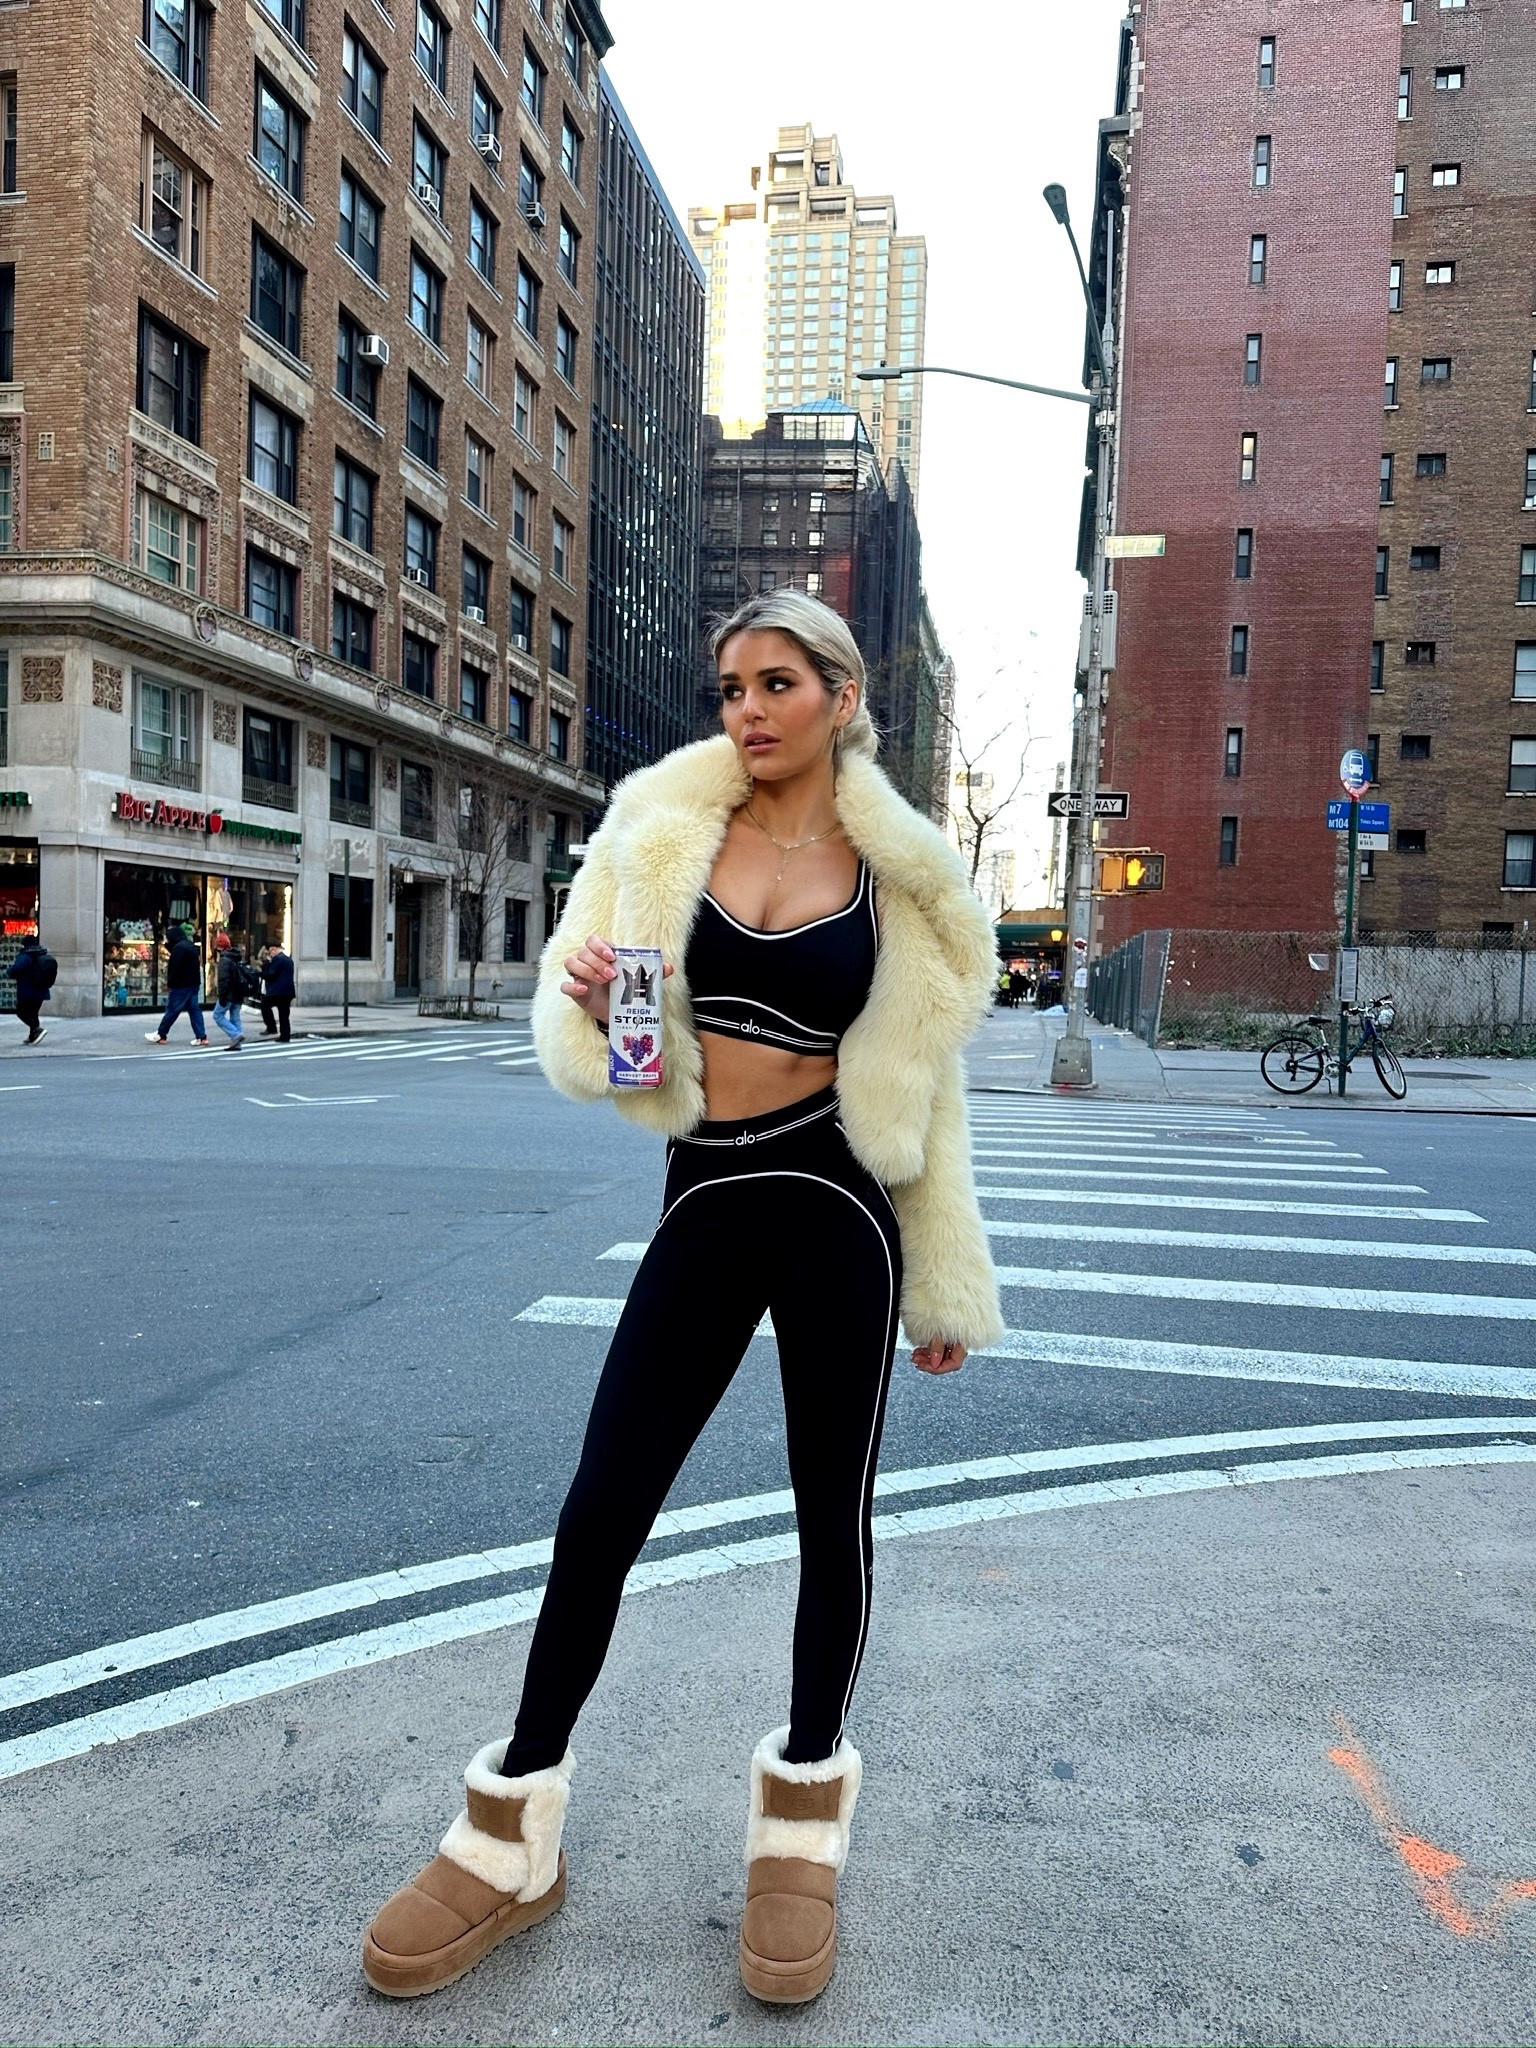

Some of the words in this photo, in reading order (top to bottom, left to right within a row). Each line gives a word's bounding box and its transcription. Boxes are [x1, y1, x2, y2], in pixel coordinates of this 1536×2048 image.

[1060, 799, 1082, 810] ONE
[1094, 800, 1118, 811] WAY
[1329, 803, 1342, 815] M7
[118, 792, 152, 823] BIG
[153, 800, 206, 832] APPLE
[1328, 818, 1349, 828] M104
[614, 1015, 660, 1025] STORM
[740, 1018, 761, 1035] alo
[735, 1130, 756, 1146] alo
